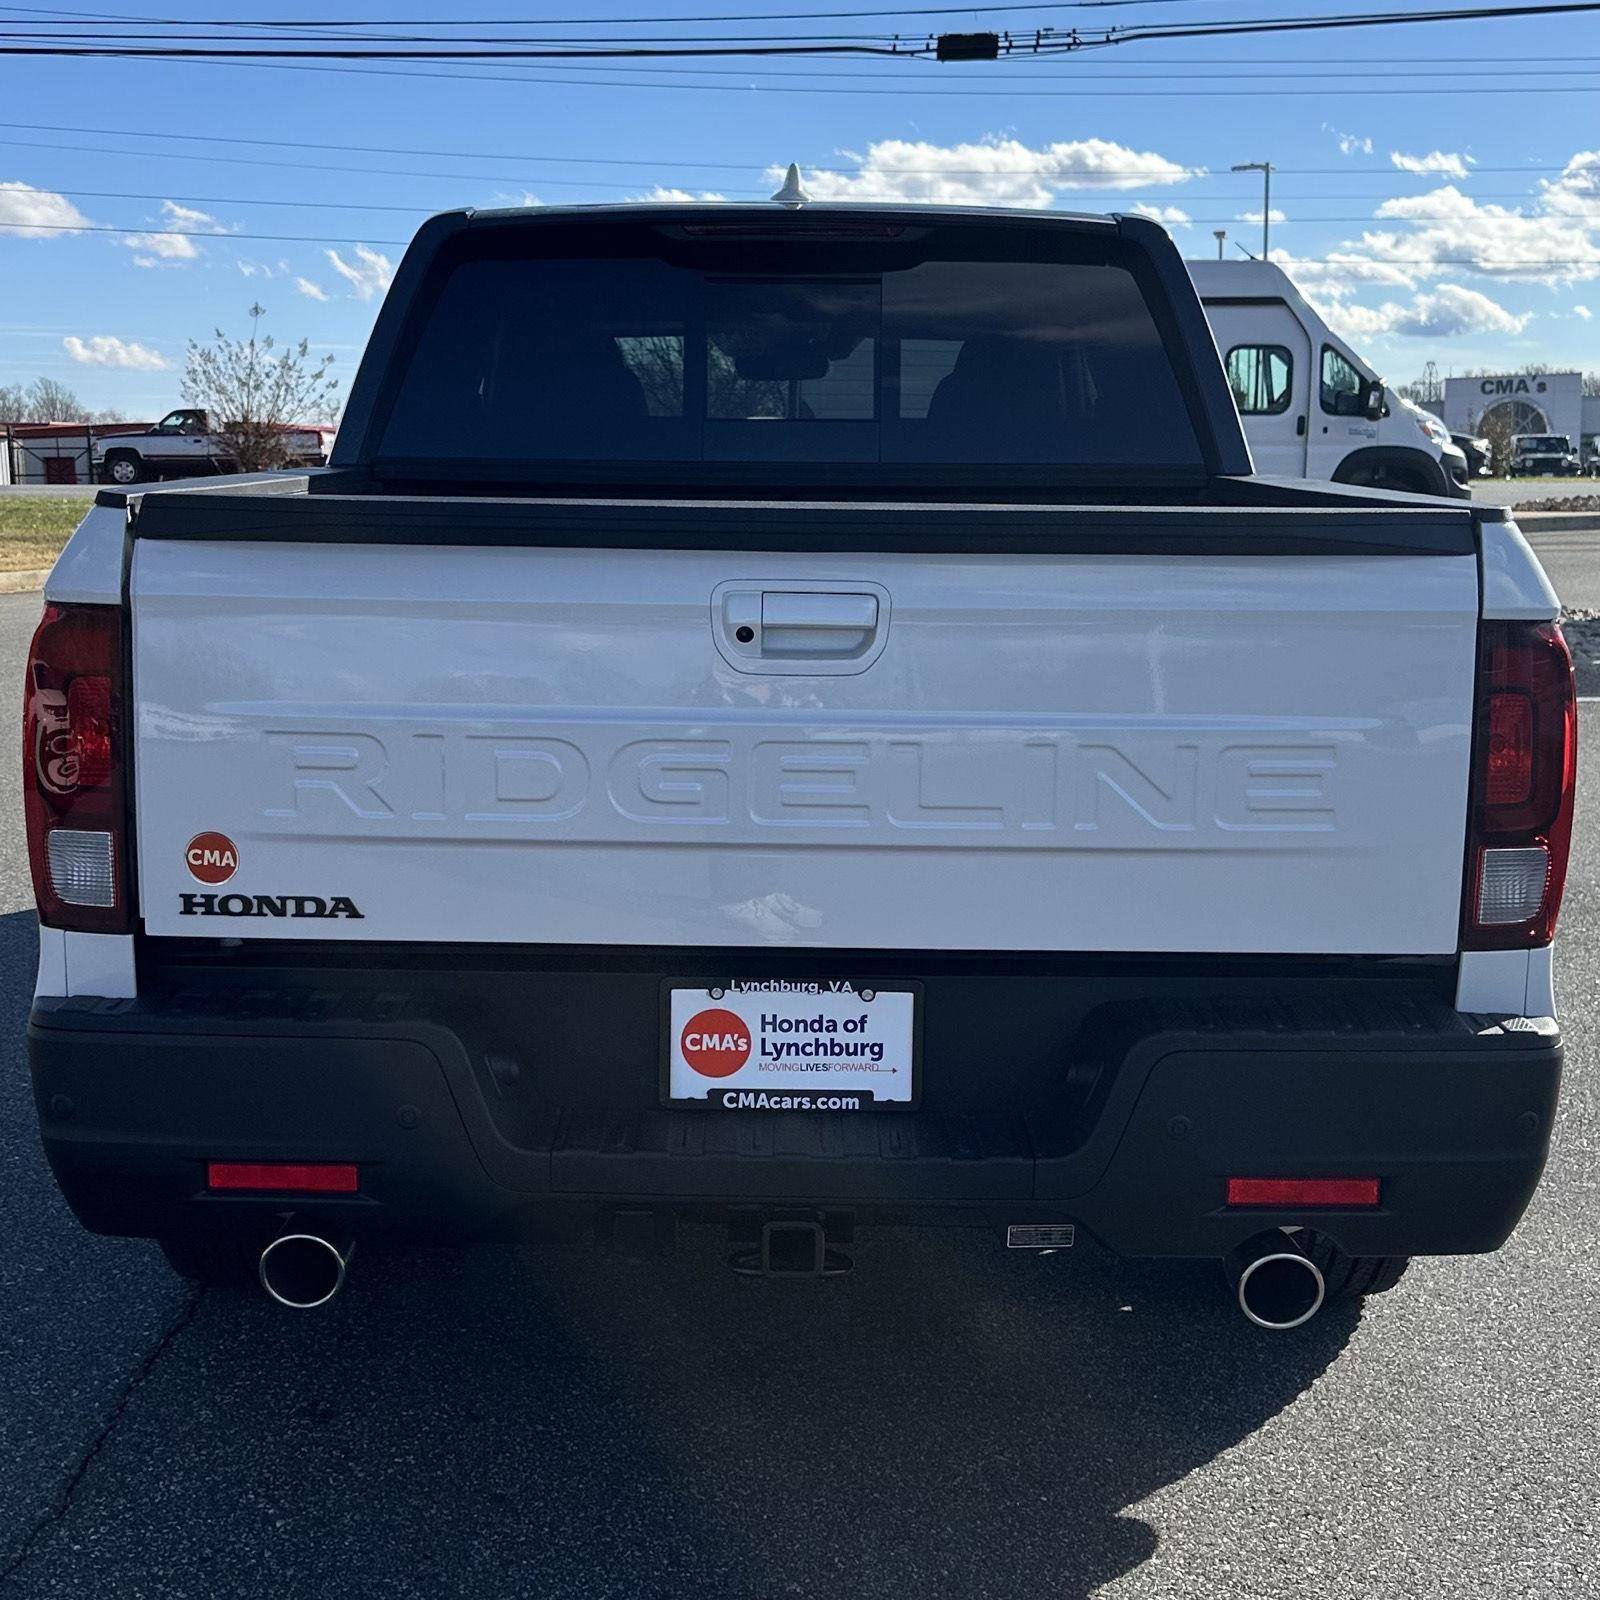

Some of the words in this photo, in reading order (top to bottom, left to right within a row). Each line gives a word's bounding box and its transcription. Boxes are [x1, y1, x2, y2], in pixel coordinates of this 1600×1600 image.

[1480, 375, 1547, 395] CMA's
[262, 729, 1337, 833] RIDGELINE
[187, 848, 236, 867] CMA
[179, 893, 365, 918] HONDA
[730, 979, 823, 994] Lynchburg,
[828, 980, 854, 993] VA
[760, 1014, 838, 1033] Honda
[843, 1014, 868, 1033] of
[685, 1033, 748, 1051] CMA's
[760, 1038, 884, 1061] Lynchburg
[722, 1092, 860, 1110] CMAcars.com
